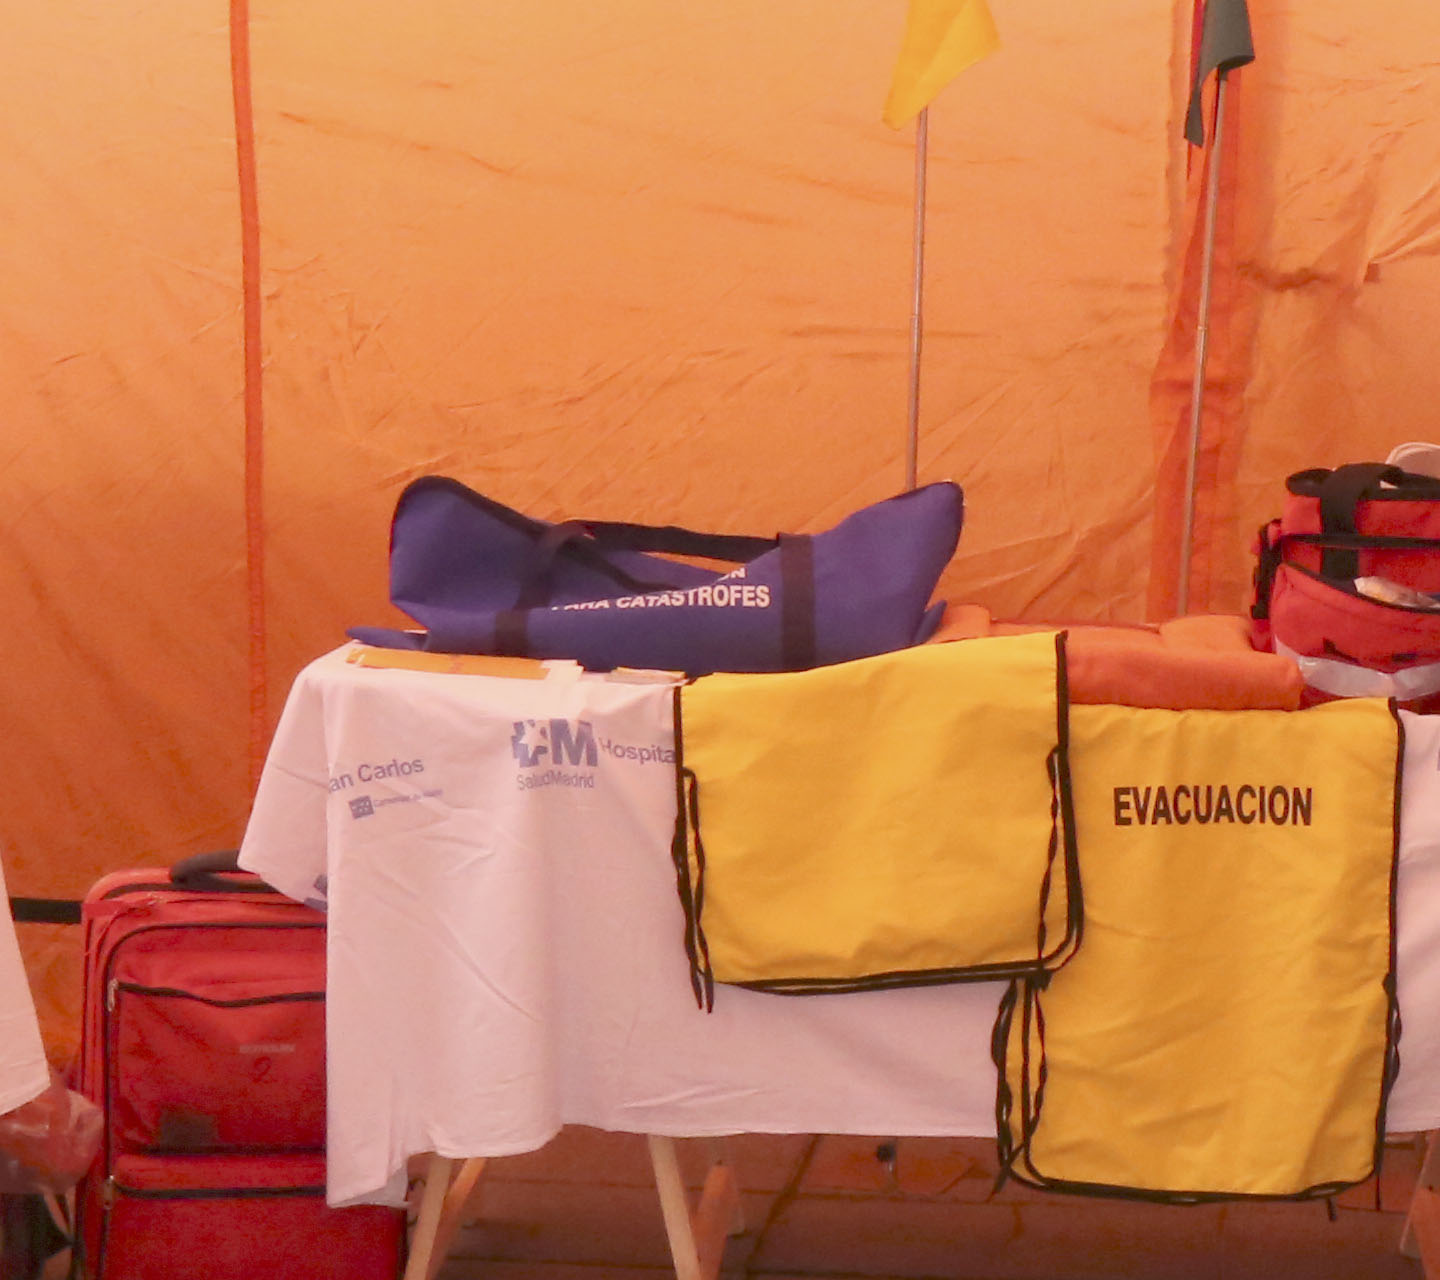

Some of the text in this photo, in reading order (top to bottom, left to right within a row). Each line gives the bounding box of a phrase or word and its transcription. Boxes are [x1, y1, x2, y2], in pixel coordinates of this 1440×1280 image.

[616, 584, 771, 609] CATASTROFES
[598, 737, 676, 765] Hospita
[327, 756, 425, 795] an Carlos
[515, 770, 596, 792] SaludMadrid
[1113, 784, 1313, 827] EVACUACION
